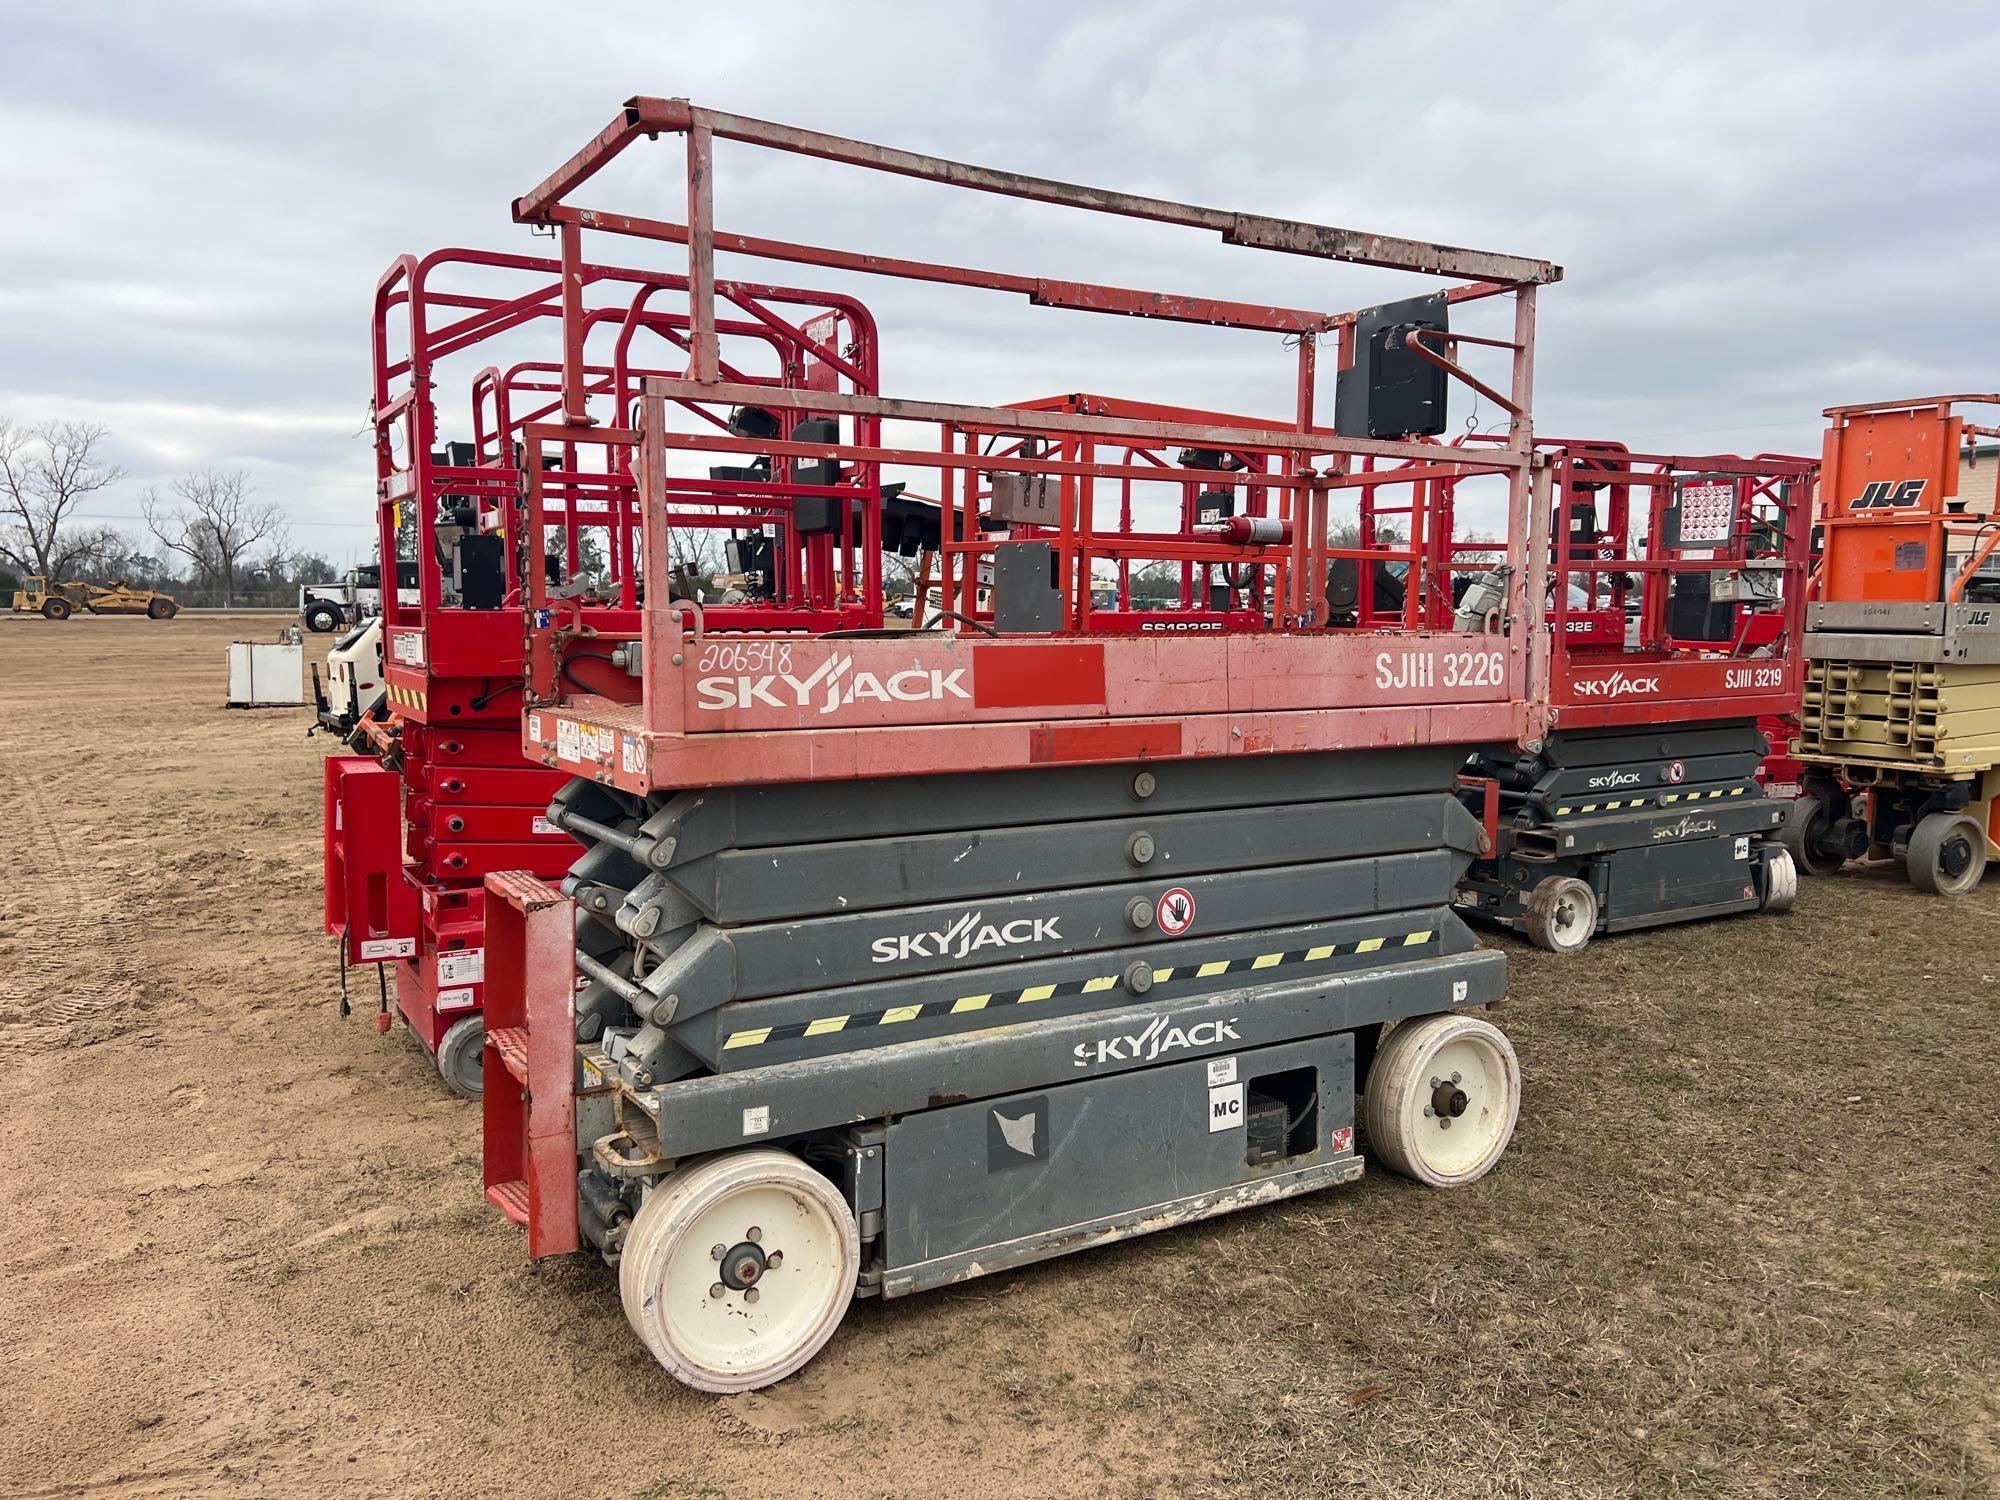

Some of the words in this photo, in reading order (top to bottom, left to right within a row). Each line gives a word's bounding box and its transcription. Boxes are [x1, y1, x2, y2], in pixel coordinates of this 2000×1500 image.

[1850, 480, 1927, 510] JLG
[1968, 611, 1990, 626] JLG
[699, 642, 793, 675] 206548
[1376, 652, 1433, 689] SJIII
[1443, 652, 1504, 687] 3226
[696, 651, 972, 714] SKYJACK
[1573, 670, 1659, 699] SKYJACK
[1725, 669, 1752, 689] SJIII
[1755, 668, 1782, 688] 3219
[1588, 770, 1641, 788] SKYJACK
[871, 911, 1064, 963] SKYJACK
[1074, 1015, 1241, 1067] SKYJACK
[1214, 1099, 1239, 1118] MC
